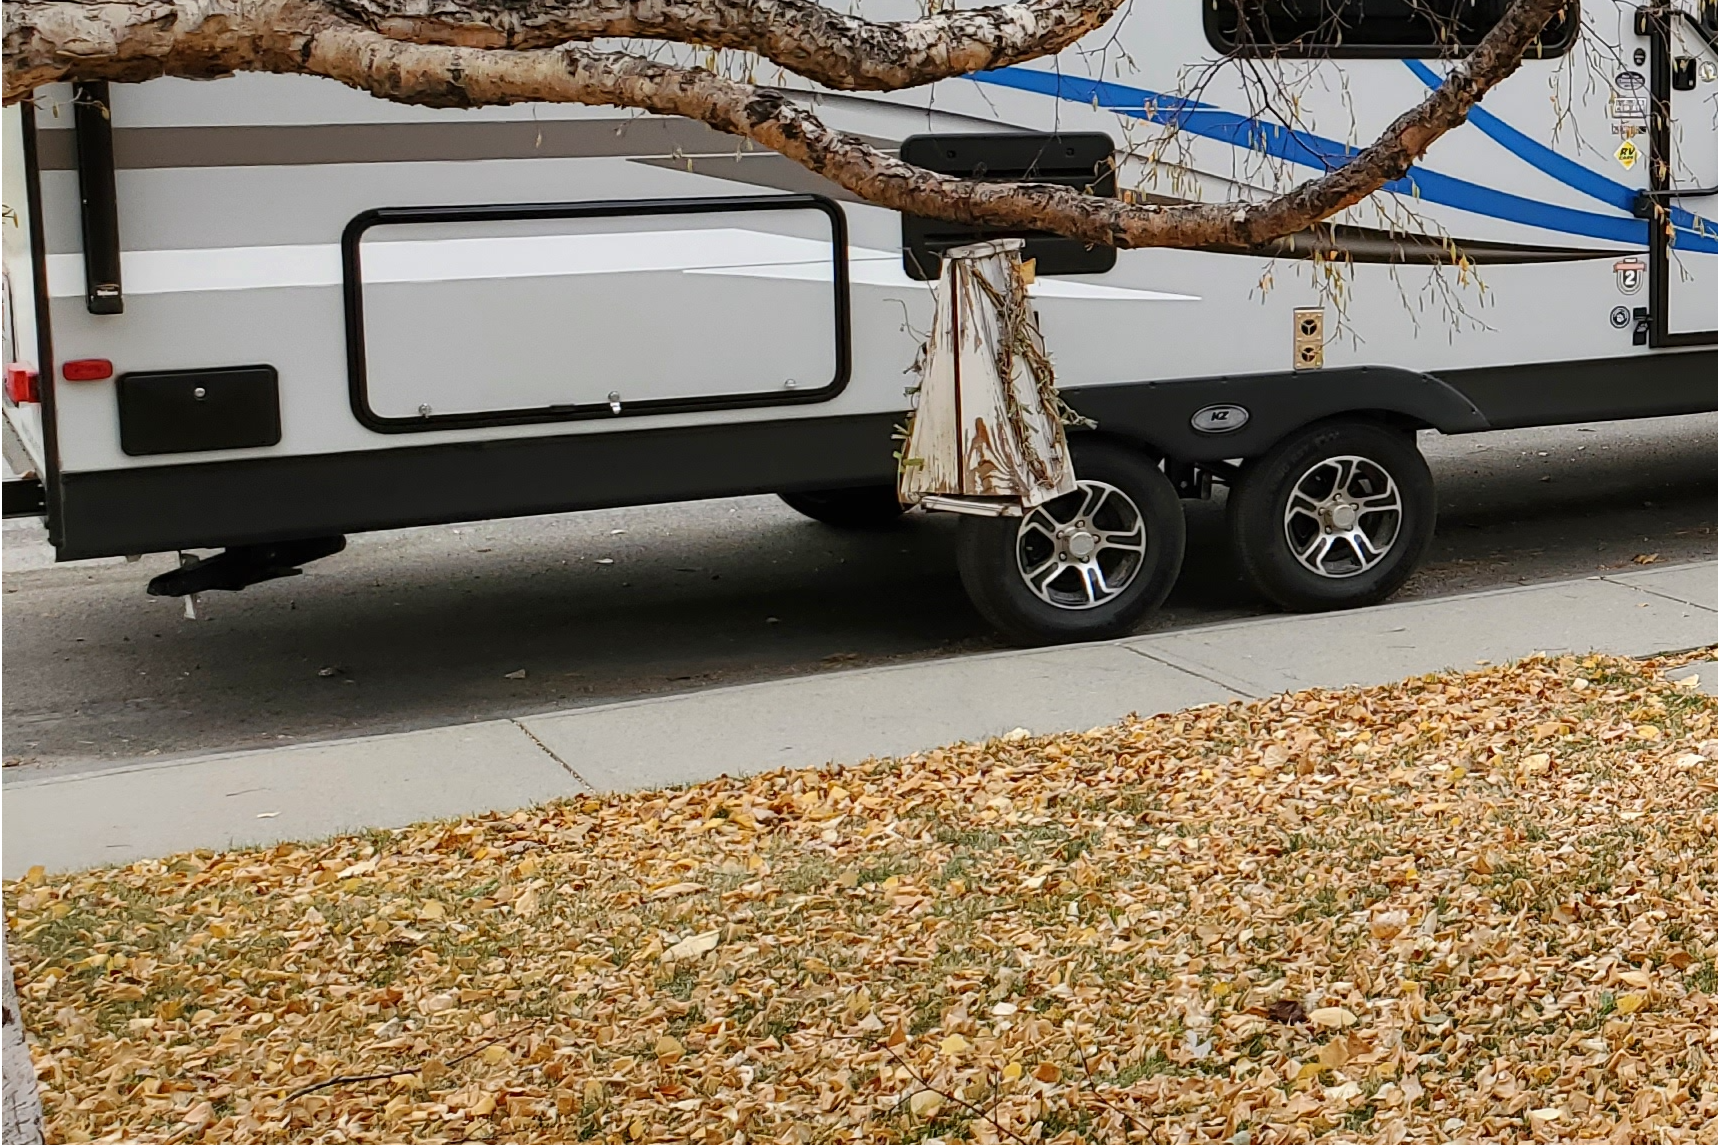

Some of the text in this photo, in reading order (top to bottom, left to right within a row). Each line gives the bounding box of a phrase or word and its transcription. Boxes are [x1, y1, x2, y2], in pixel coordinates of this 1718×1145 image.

[1620, 147, 1635, 156] RV
[1624, 269, 1636, 286] 2
[1211, 410, 1230, 422] KZ
